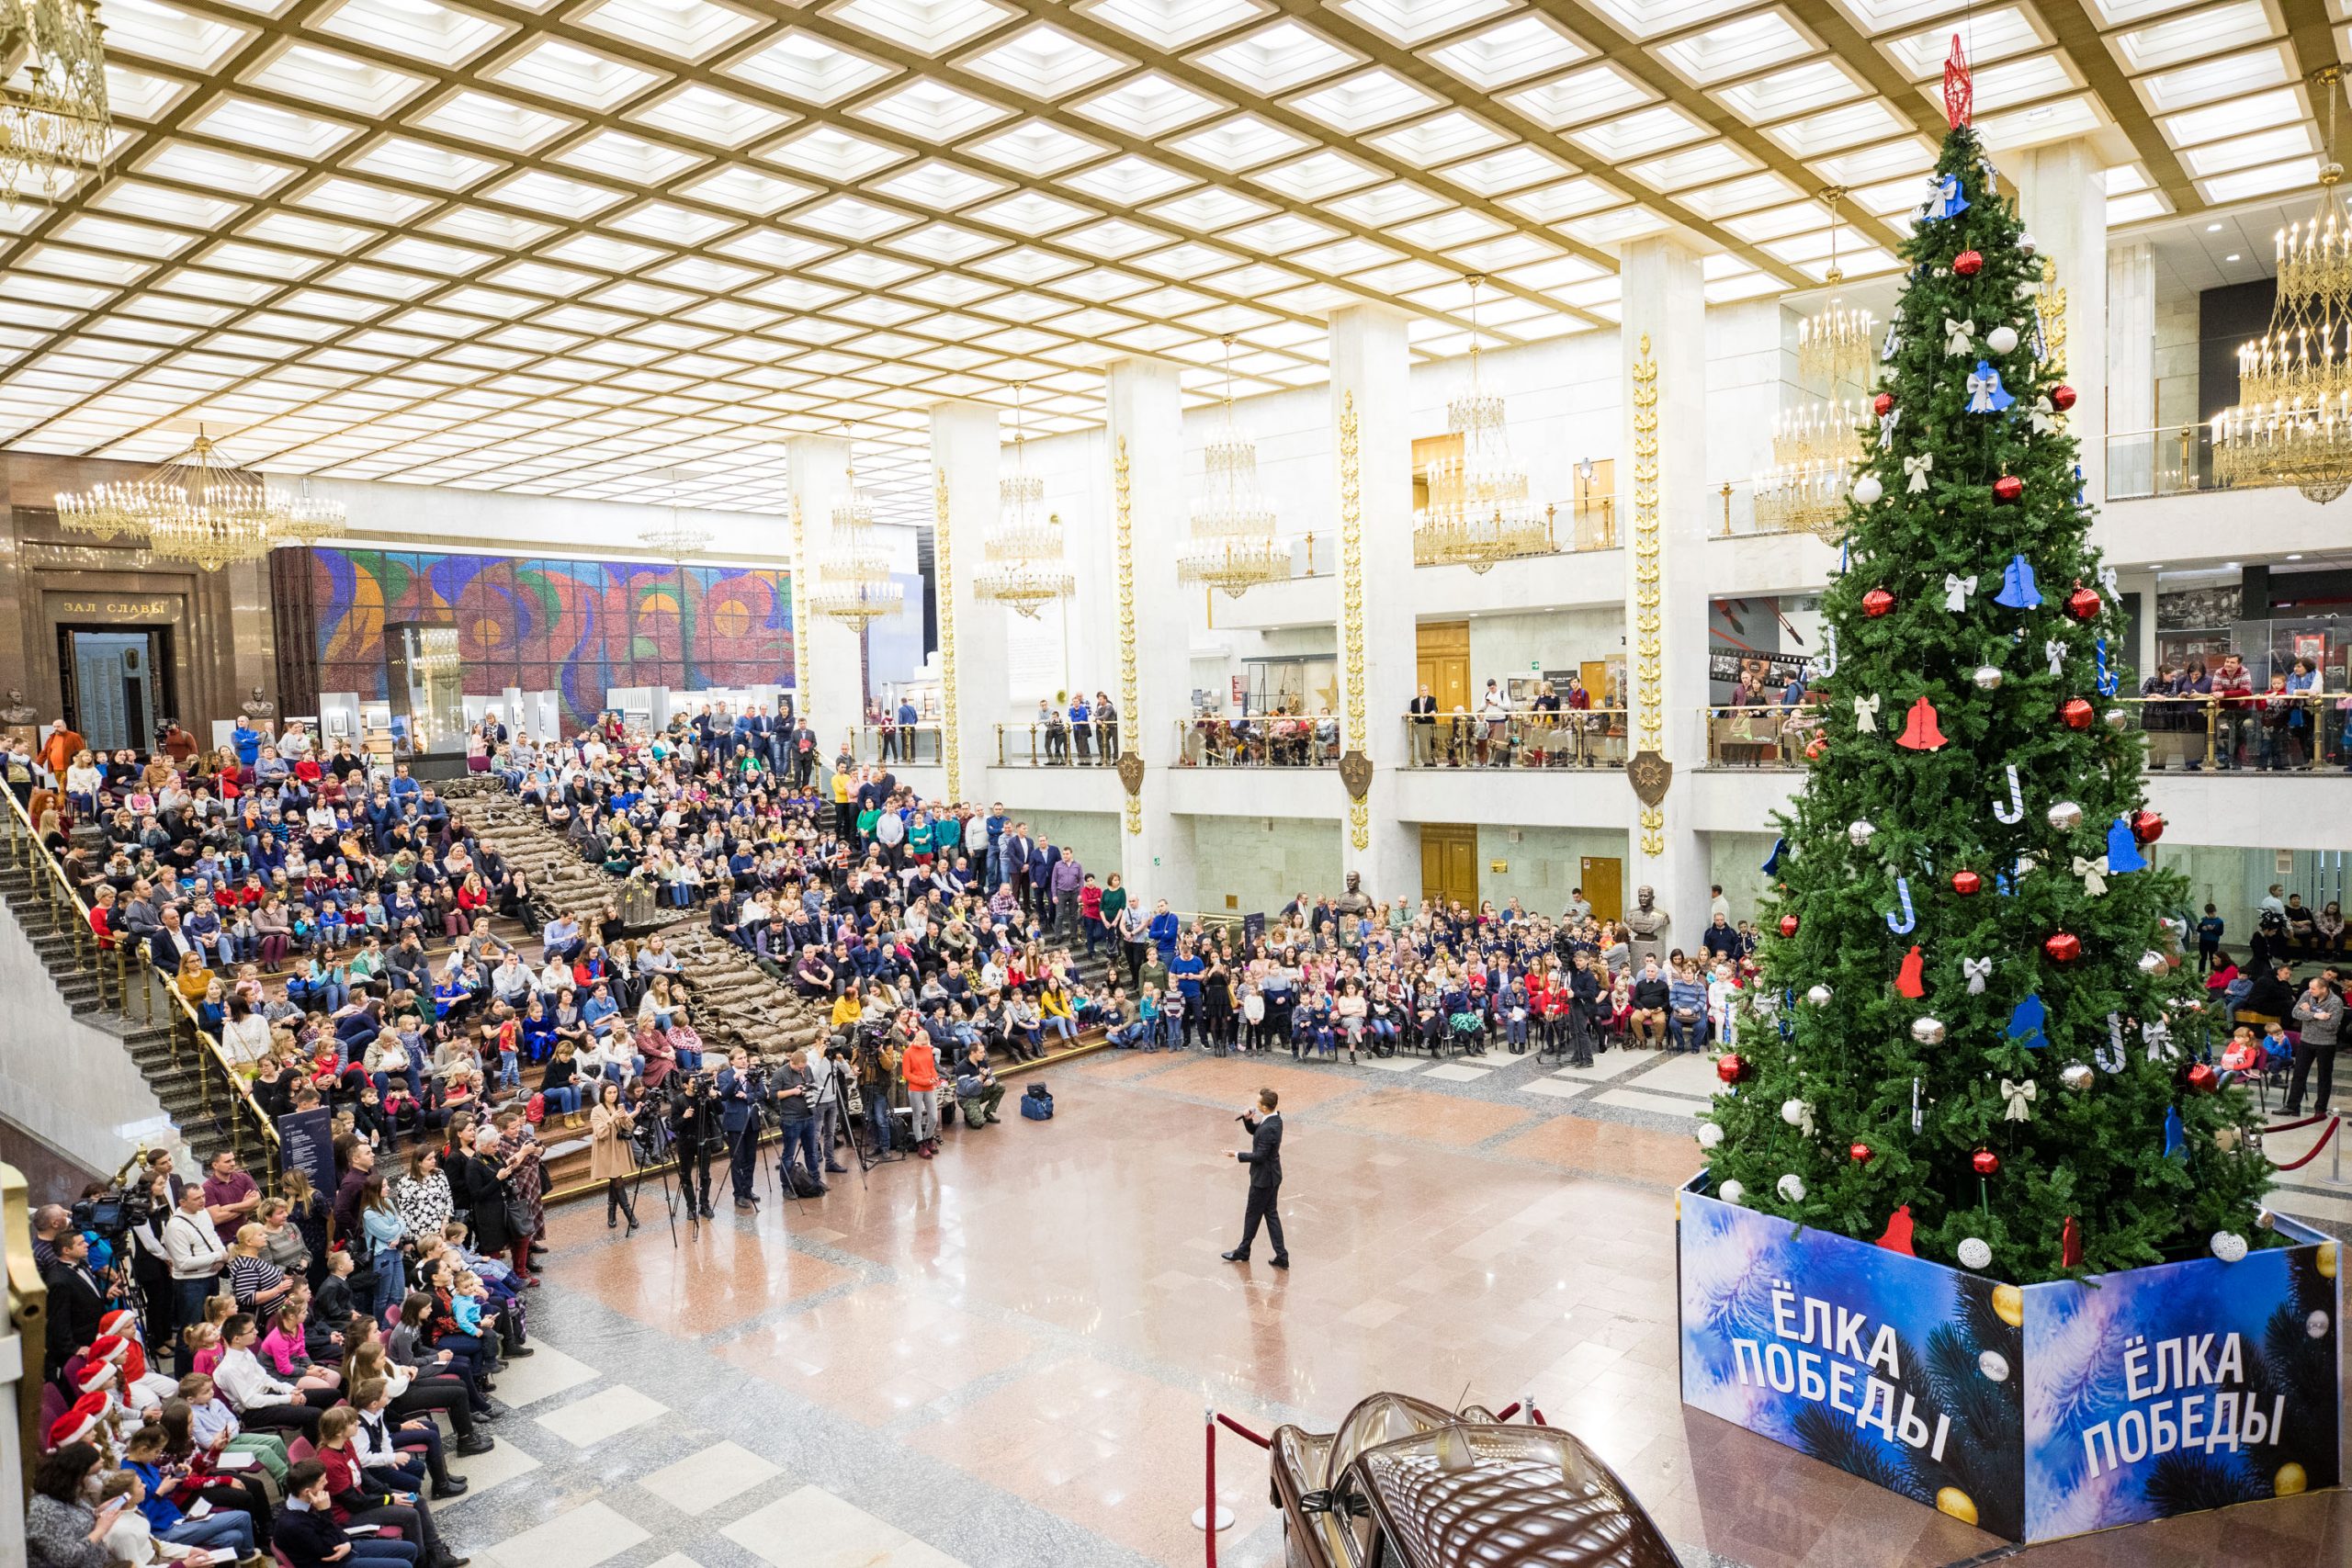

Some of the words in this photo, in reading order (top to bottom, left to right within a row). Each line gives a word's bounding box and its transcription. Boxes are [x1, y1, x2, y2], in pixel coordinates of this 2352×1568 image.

[63, 603, 96, 613] ЗАЛ
[107, 604, 165, 614] СЛАВЫ
[1771, 1280, 1901, 1379] ЁЛКА
[2123, 1332, 2245, 1401] ЁЛКА
[1733, 1337, 1951, 1462] ПОБЕДЫ
[2082, 1393, 2286, 1479] ПОБЕДЫ
